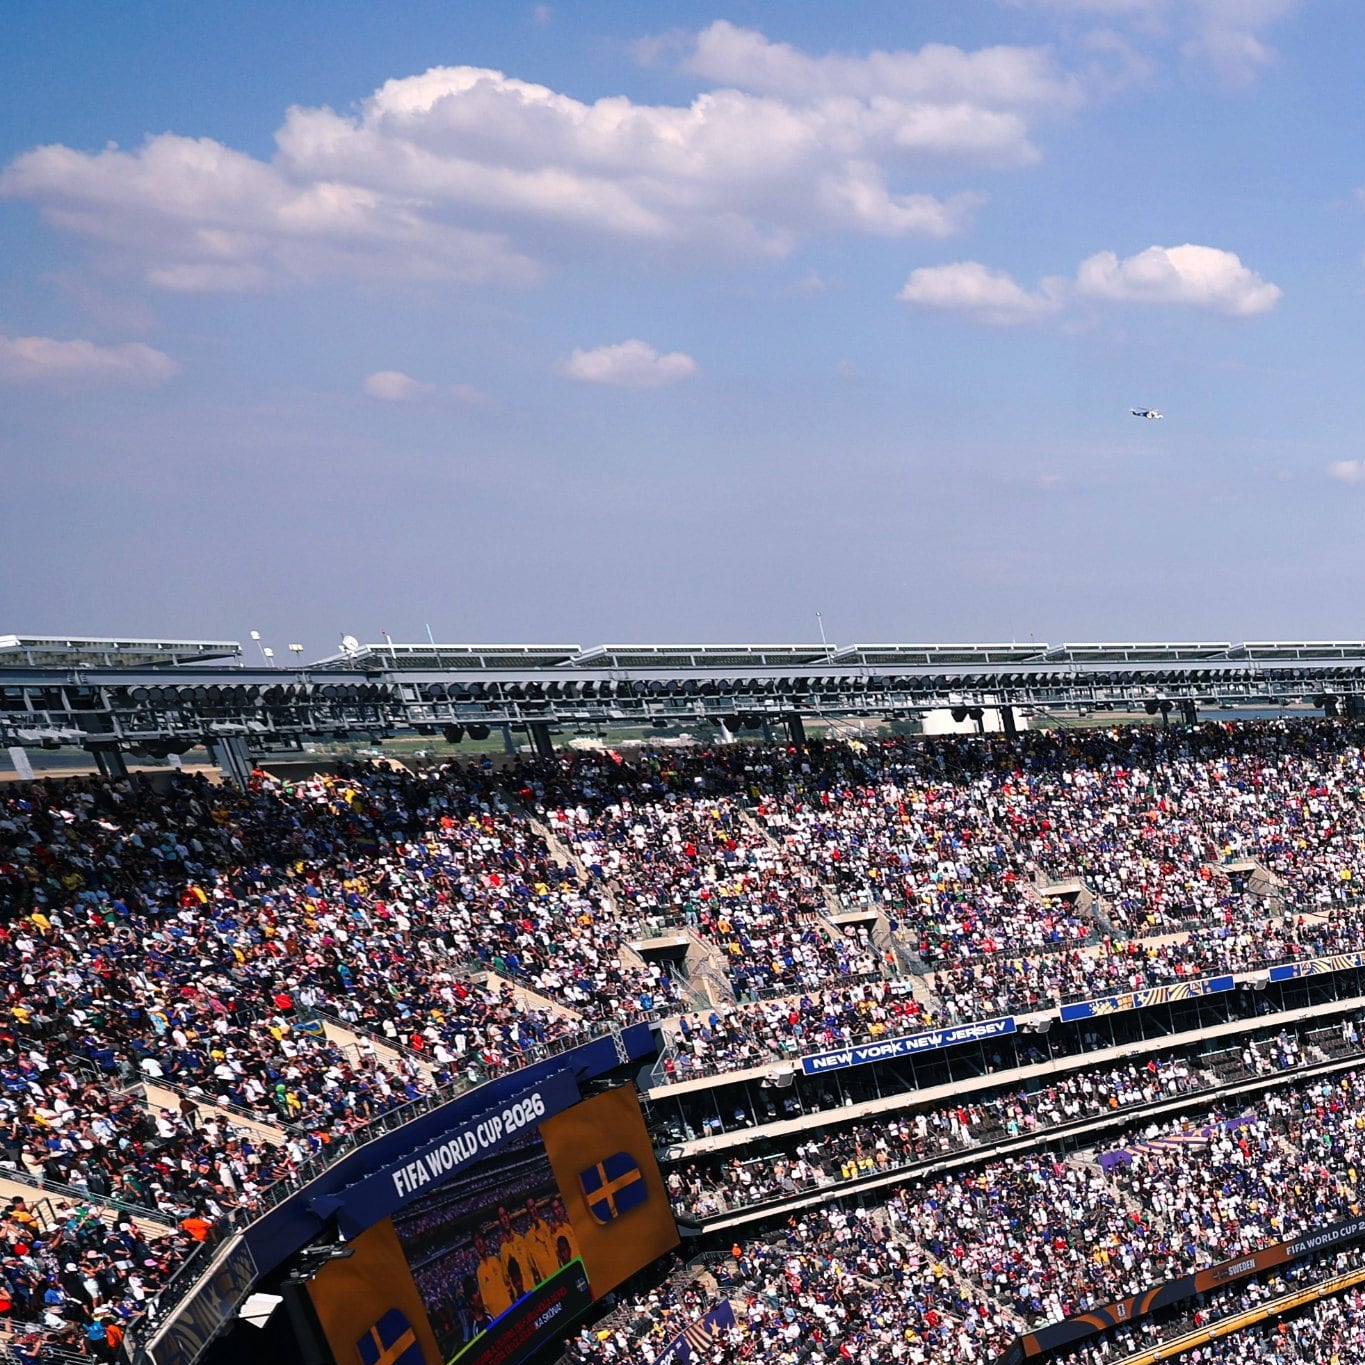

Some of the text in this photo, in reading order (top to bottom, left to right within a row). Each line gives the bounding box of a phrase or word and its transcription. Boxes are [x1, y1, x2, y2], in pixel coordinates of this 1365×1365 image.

[812, 1022, 1007, 1069] NEW YORK NEW JERSEY
[391, 1093, 545, 1198] FIFA WORLD CUP 2026
[1286, 1241, 1306, 1256] FIFA
[1307, 1232, 1339, 1248] WORLD
[1340, 1224, 1357, 1237] CUP
[1227, 1258, 1256, 1276] SWEDEN
